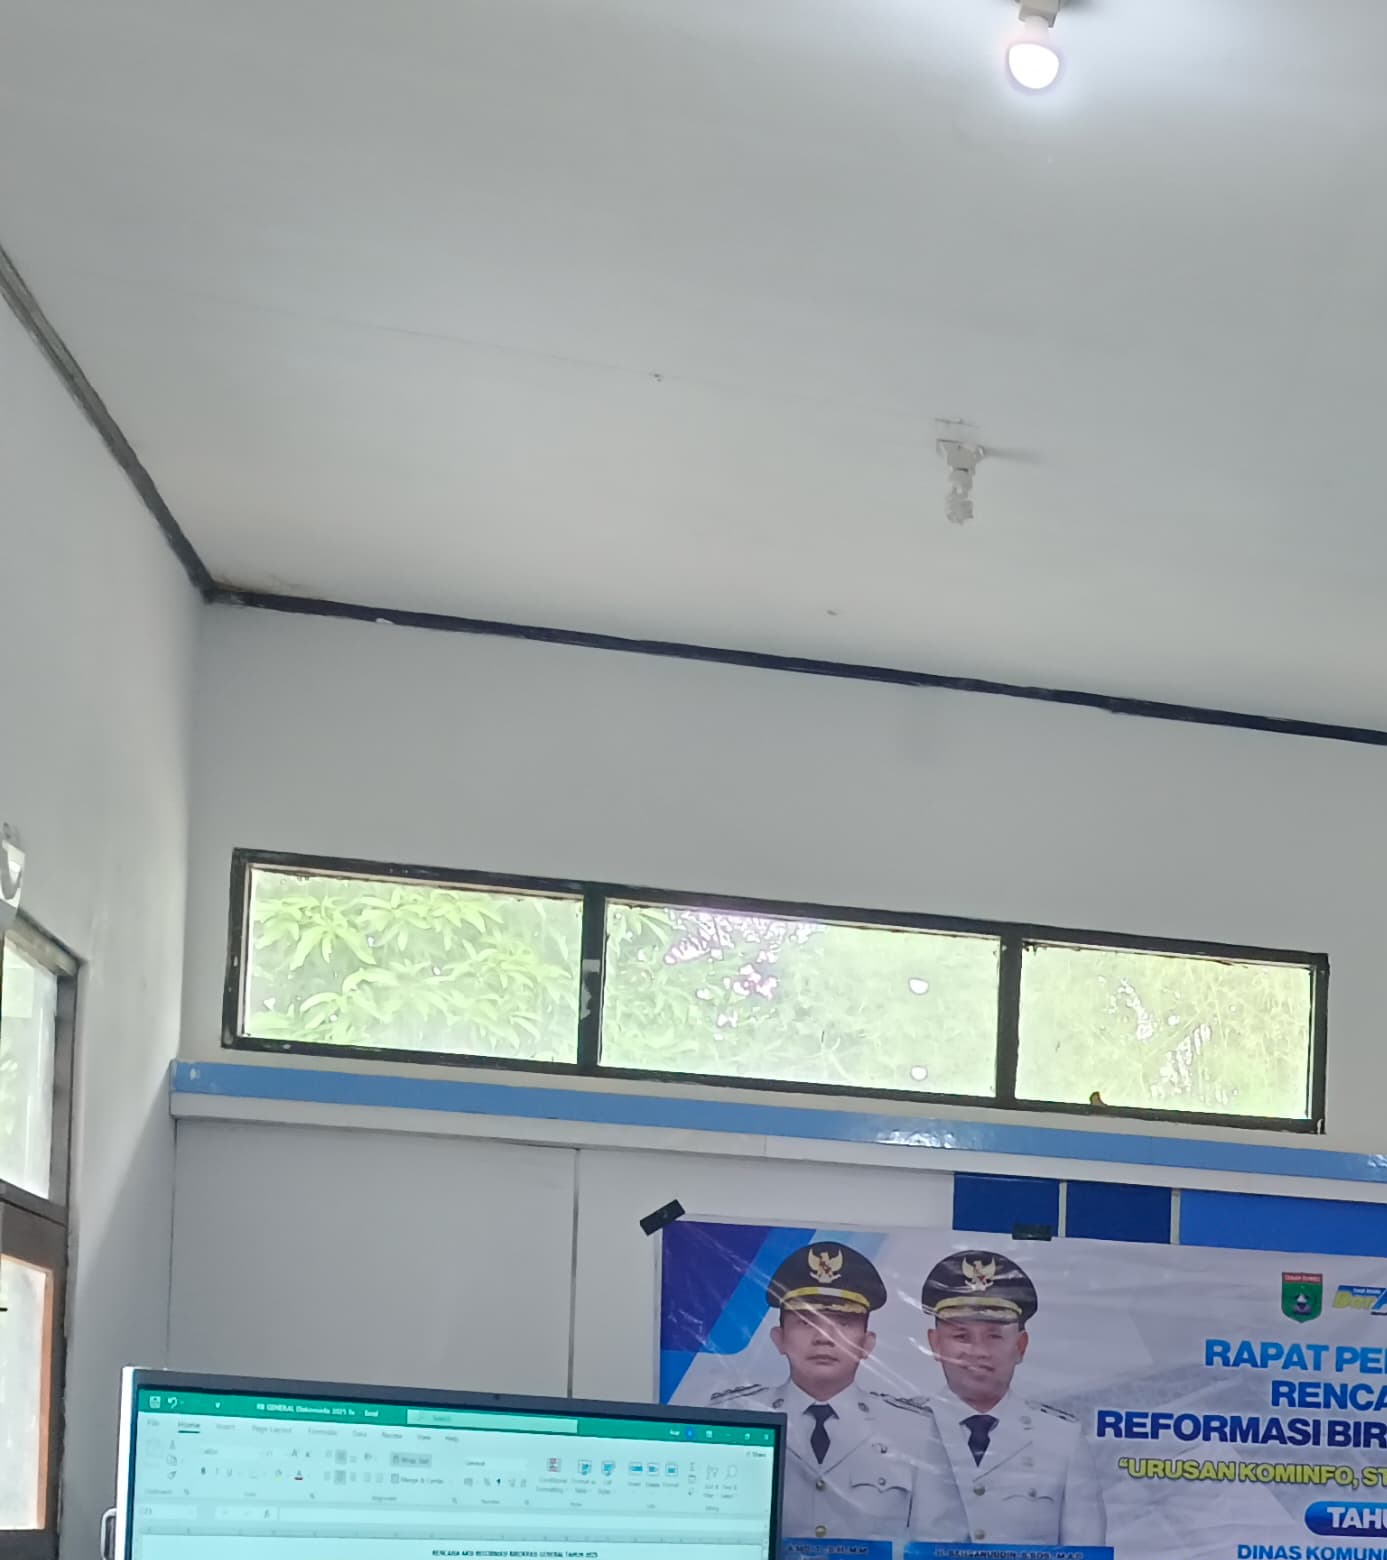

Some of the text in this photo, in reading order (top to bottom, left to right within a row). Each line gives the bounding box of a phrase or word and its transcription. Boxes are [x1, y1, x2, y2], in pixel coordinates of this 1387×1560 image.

[1205, 1338, 1330, 1371] RAPAT
[1096, 1410, 1321, 1446] REFORMASI
[1238, 1461, 1359, 1489] KOMINFO,
[1236, 1544, 1302, 1560] DINAS
